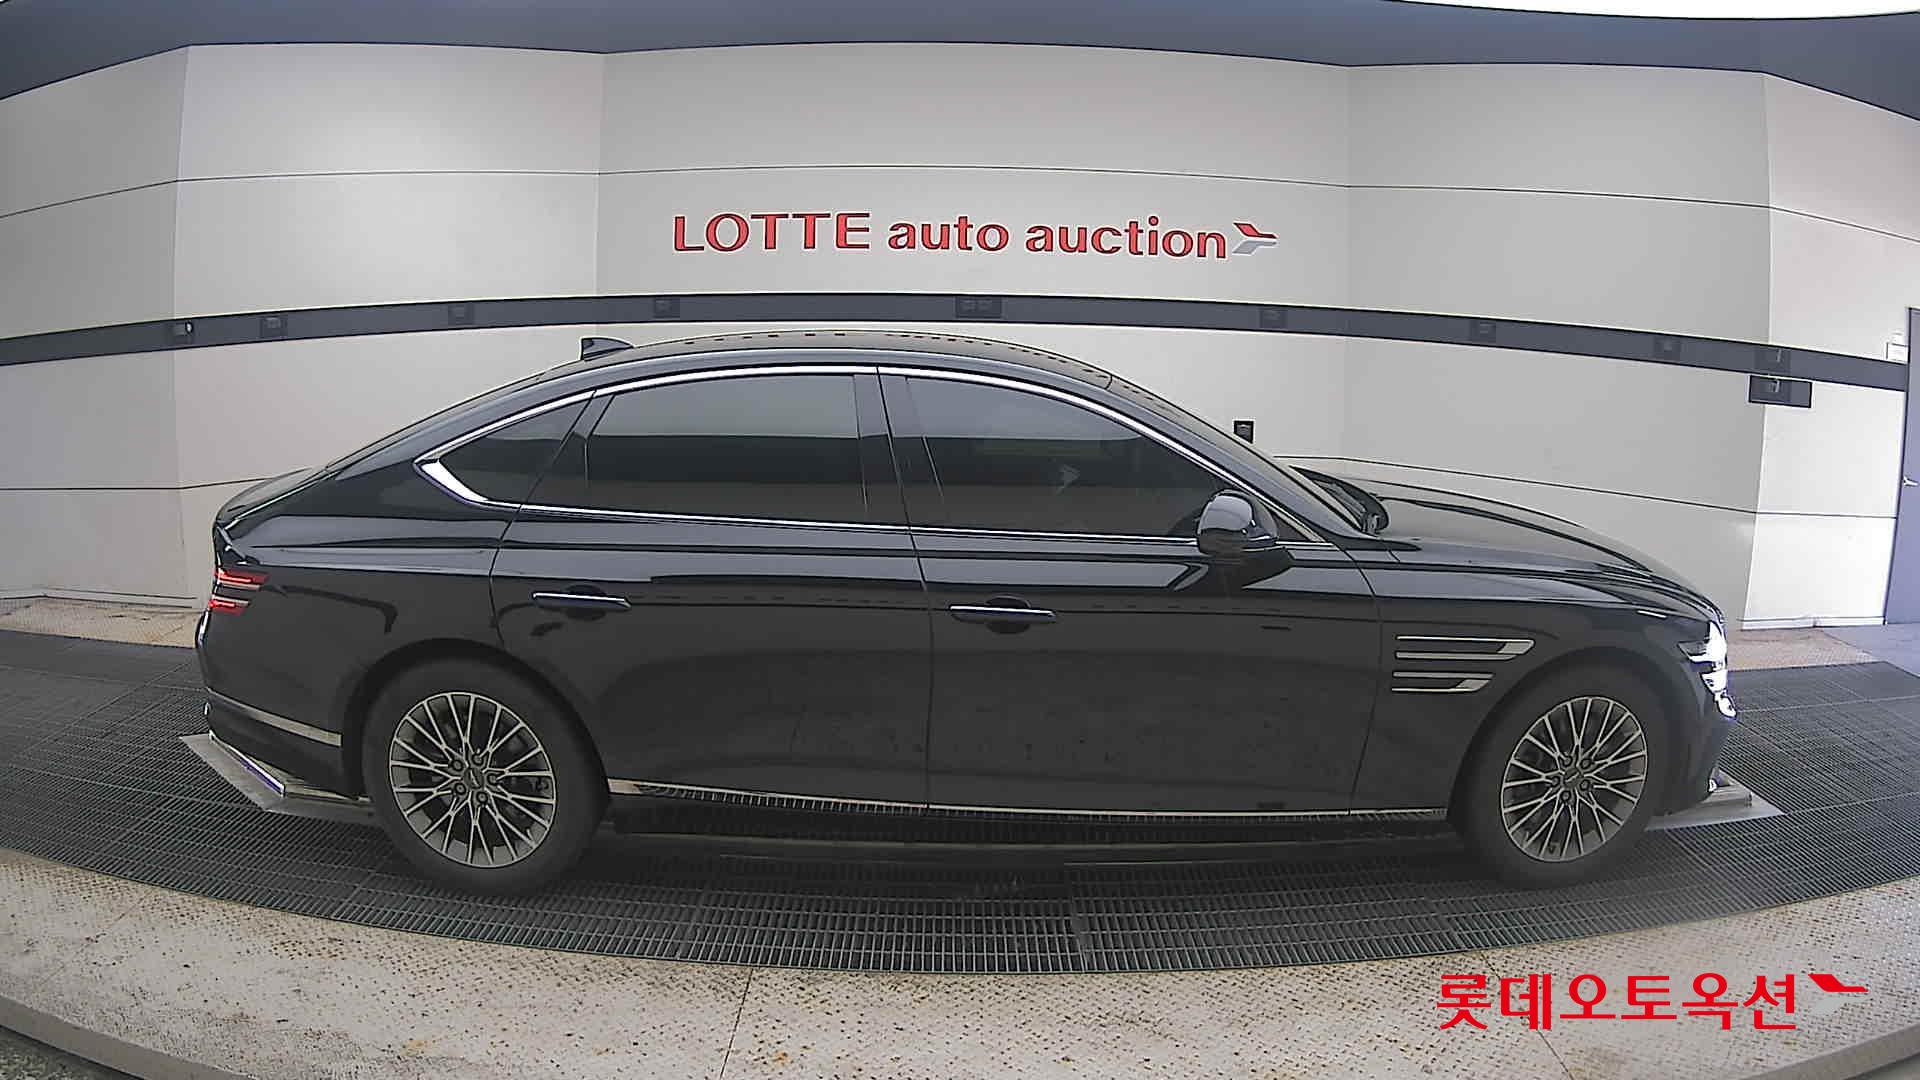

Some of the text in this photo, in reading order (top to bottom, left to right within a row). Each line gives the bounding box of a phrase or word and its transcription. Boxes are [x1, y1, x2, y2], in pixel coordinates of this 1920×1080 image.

[673, 213, 1227, 258] LOTTE auto auction
